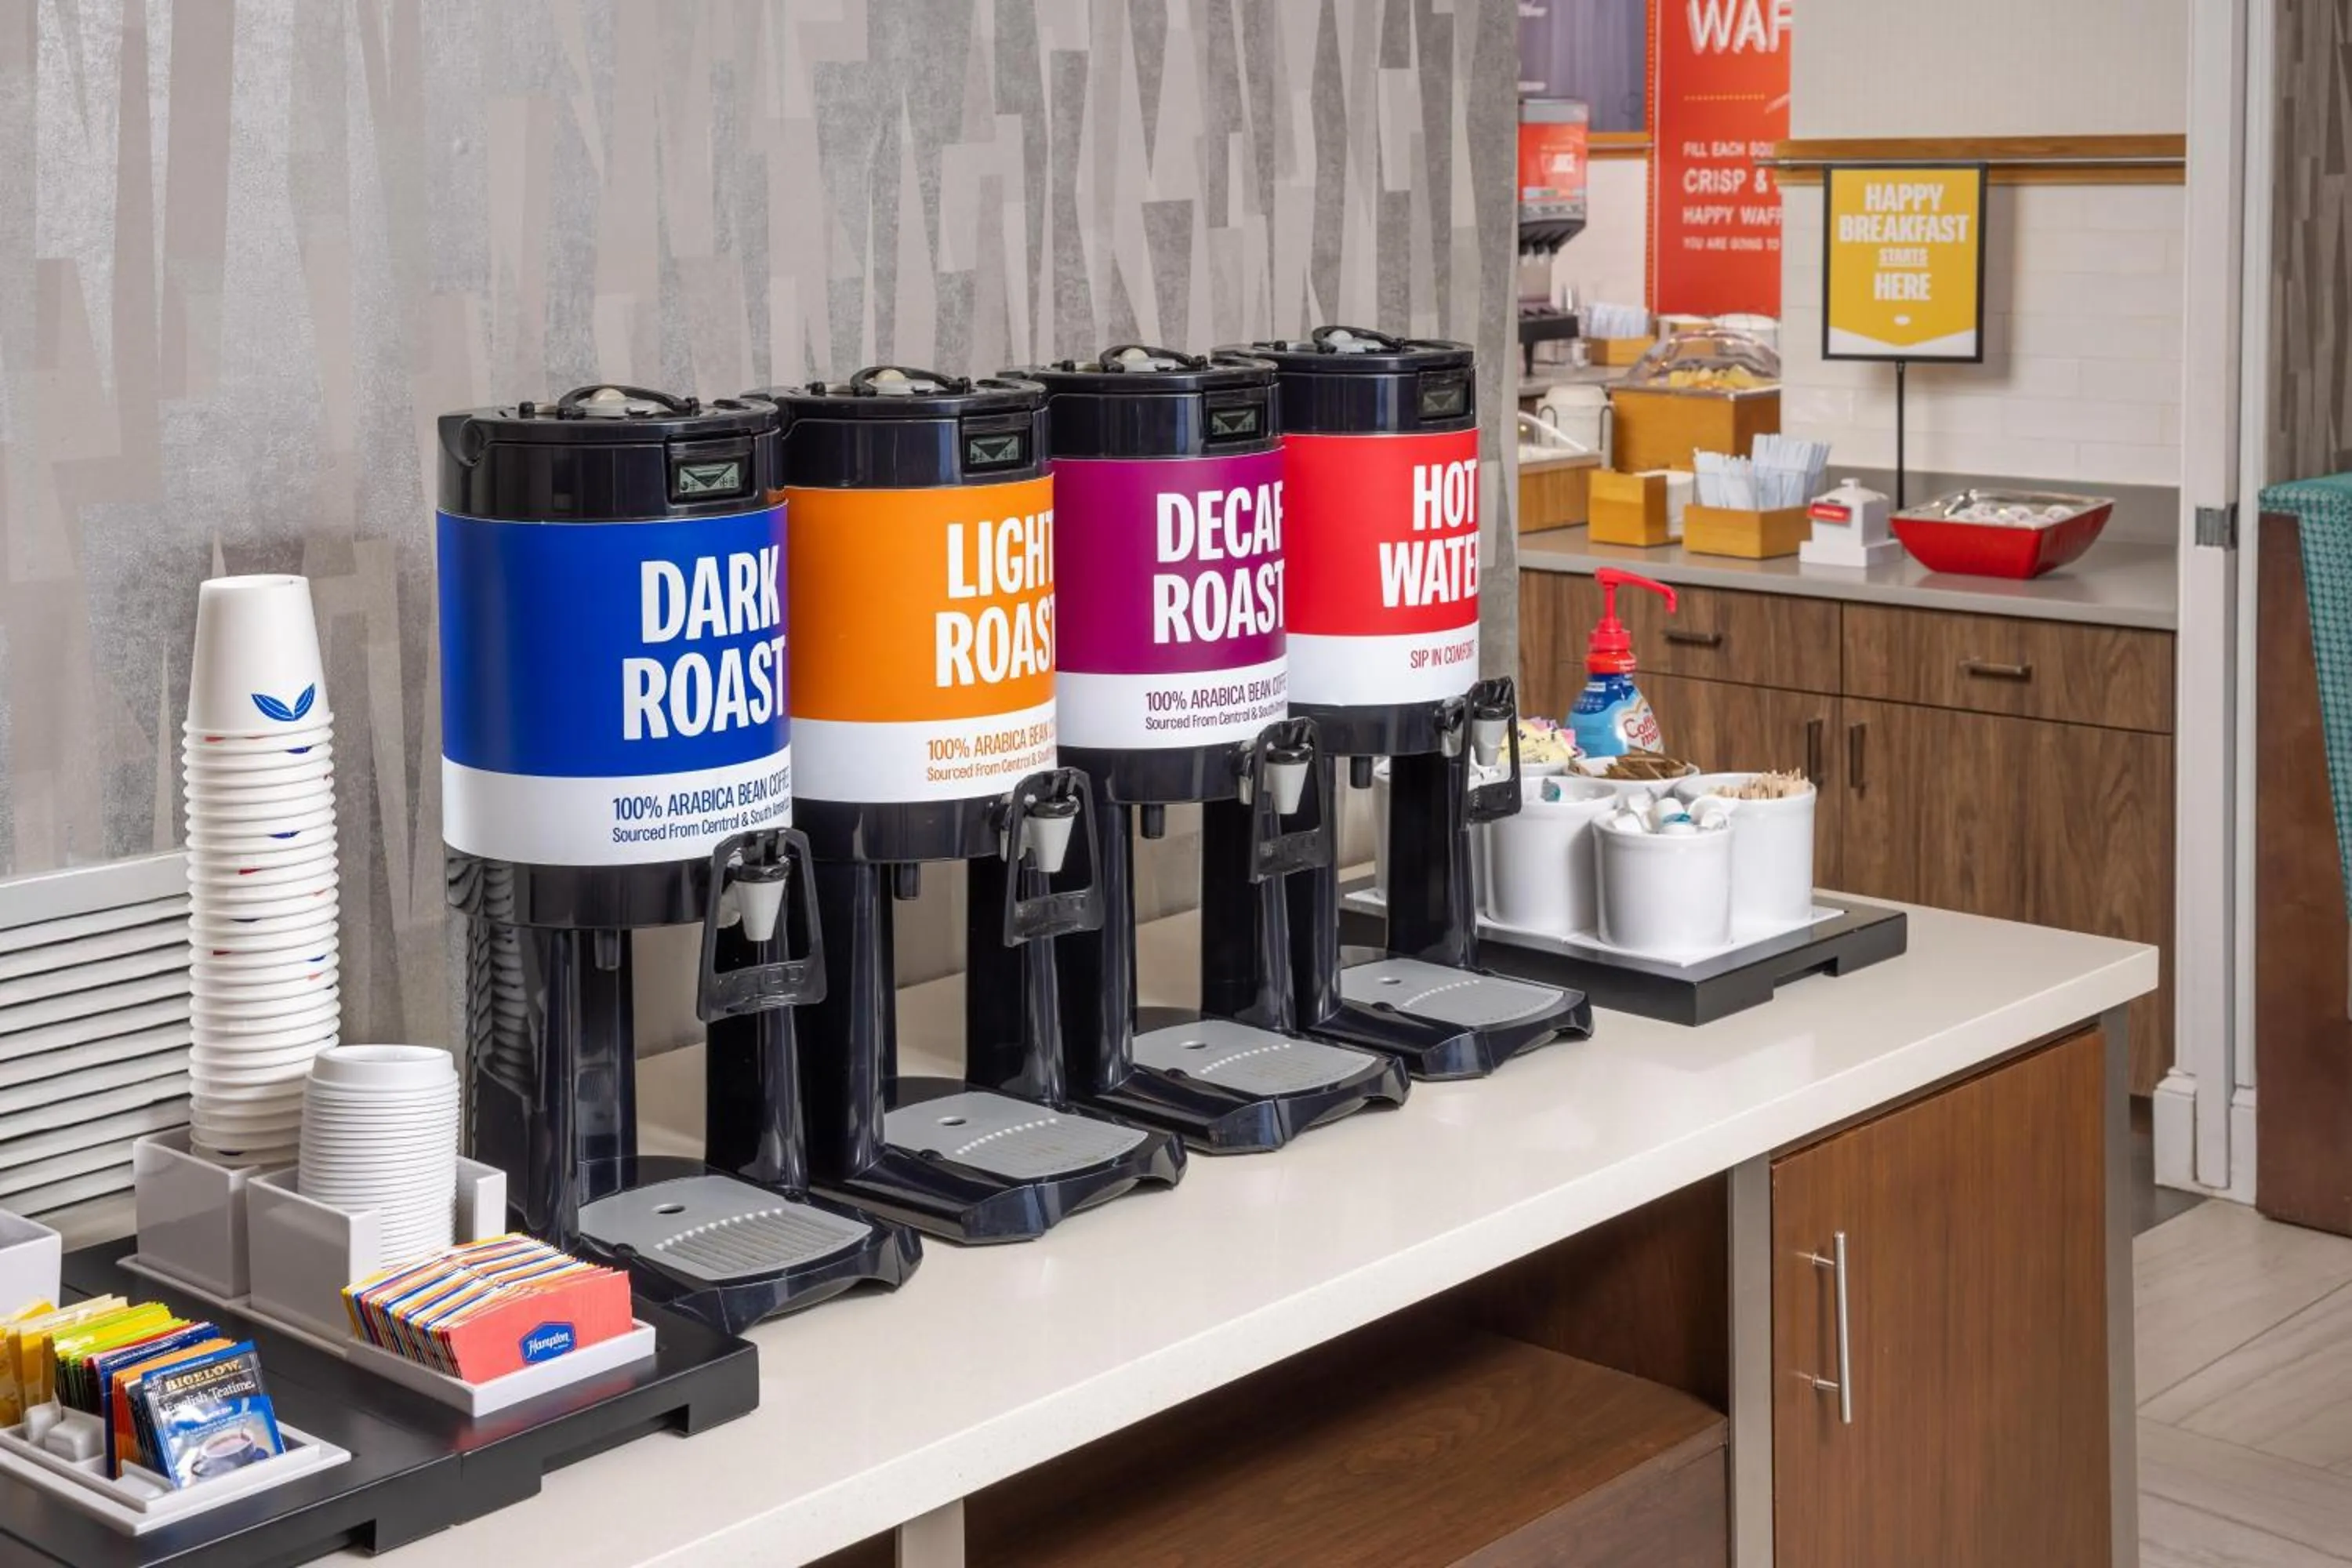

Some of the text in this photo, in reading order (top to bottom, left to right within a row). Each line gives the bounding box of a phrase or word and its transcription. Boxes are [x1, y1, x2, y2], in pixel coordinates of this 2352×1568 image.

[1683, 168, 1768, 194] CRISP &
[1865, 183, 1944, 212] HAPPY
[1682, 205, 1734, 226] HAPPY
[1839, 214, 1970, 243] BREAKFAST
[1878, 248, 1928, 265] STARTS
[1874, 273, 1933, 301] HERE
[1414, 458, 1477, 531] HOT
[1156, 480, 1283, 563] DECAF
[641, 545, 780, 644] DARK
[1153, 558, 1286, 644] ROAST
[1410, 649, 1429, 669] SIP
[1432, 648, 1442, 667] IN
[622, 635, 786, 741] ROAST
[1145, 691, 1187, 712] 100%
[1190, 684, 1246, 710] ARABICA
[1248, 679, 1270, 702] BEAN
[1145, 714, 1191, 730] Sourced
[1192, 714, 1217, 728] From
[1219, 708, 1250, 725] Central
[1251, 707, 1258, 720] &
[927, 737, 970, 760] 100%
[975, 728, 1026, 757] ARABICA
[1029, 722, 1048, 747] BEAN
[927, 764, 973, 782] Sourced
[975, 763, 1000, 776] From
[1001, 754, 1030, 773] Central
[612, 795, 662, 821] 100%
[667, 786, 735, 817] ARABICA
[738, 777, 768, 807] BEAN
[612, 822, 666, 843] Sourced
[669, 822, 700, 839] From
[702, 811, 739, 835] Central
[742, 811, 749, 826] &
[750, 804, 771, 825] South
[527, 1331, 568, 1359] Hampton
[165, 1360, 241, 1392] BIGELOW
